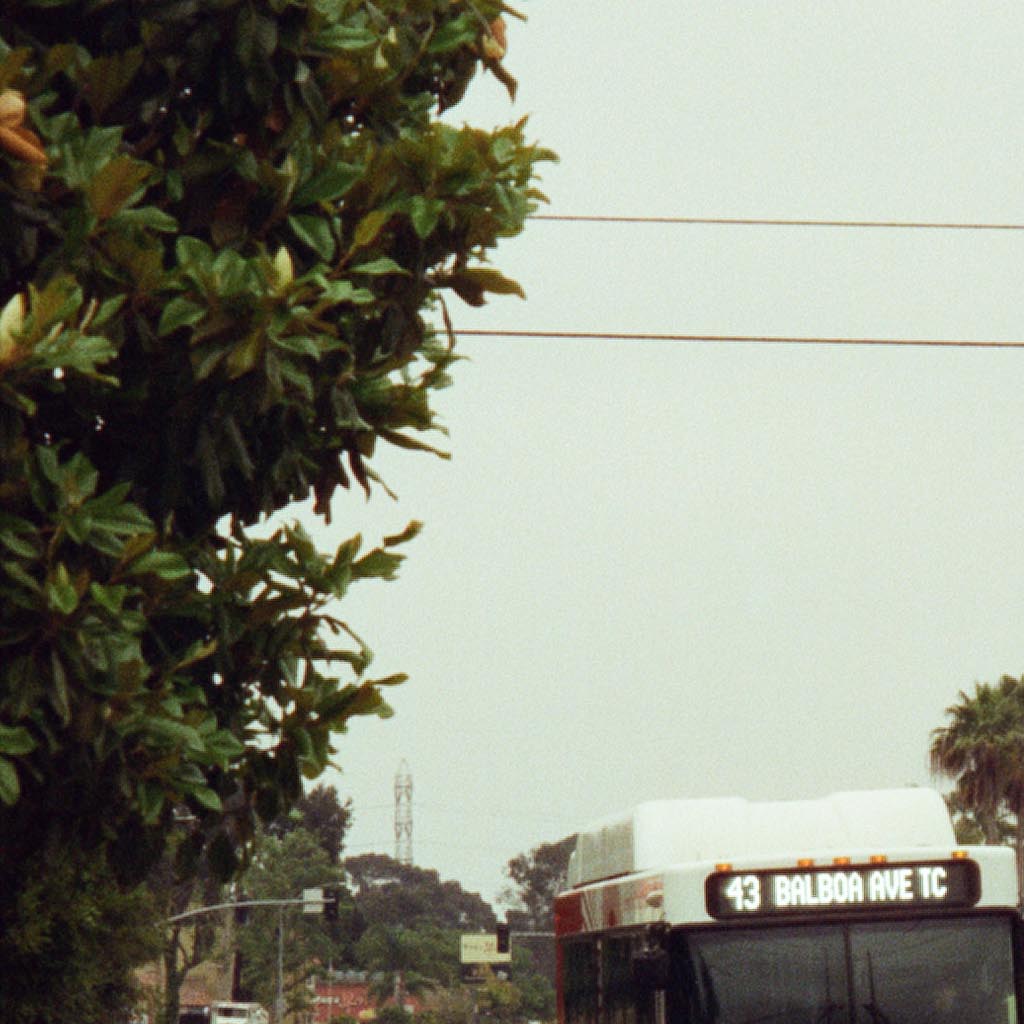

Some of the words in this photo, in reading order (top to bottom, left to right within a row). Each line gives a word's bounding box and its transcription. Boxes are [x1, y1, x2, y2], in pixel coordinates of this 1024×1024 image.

[725, 875, 761, 911] 43
[774, 871, 863, 906] BALBOA
[869, 867, 914, 900] AVE
[919, 866, 948, 898] TC
